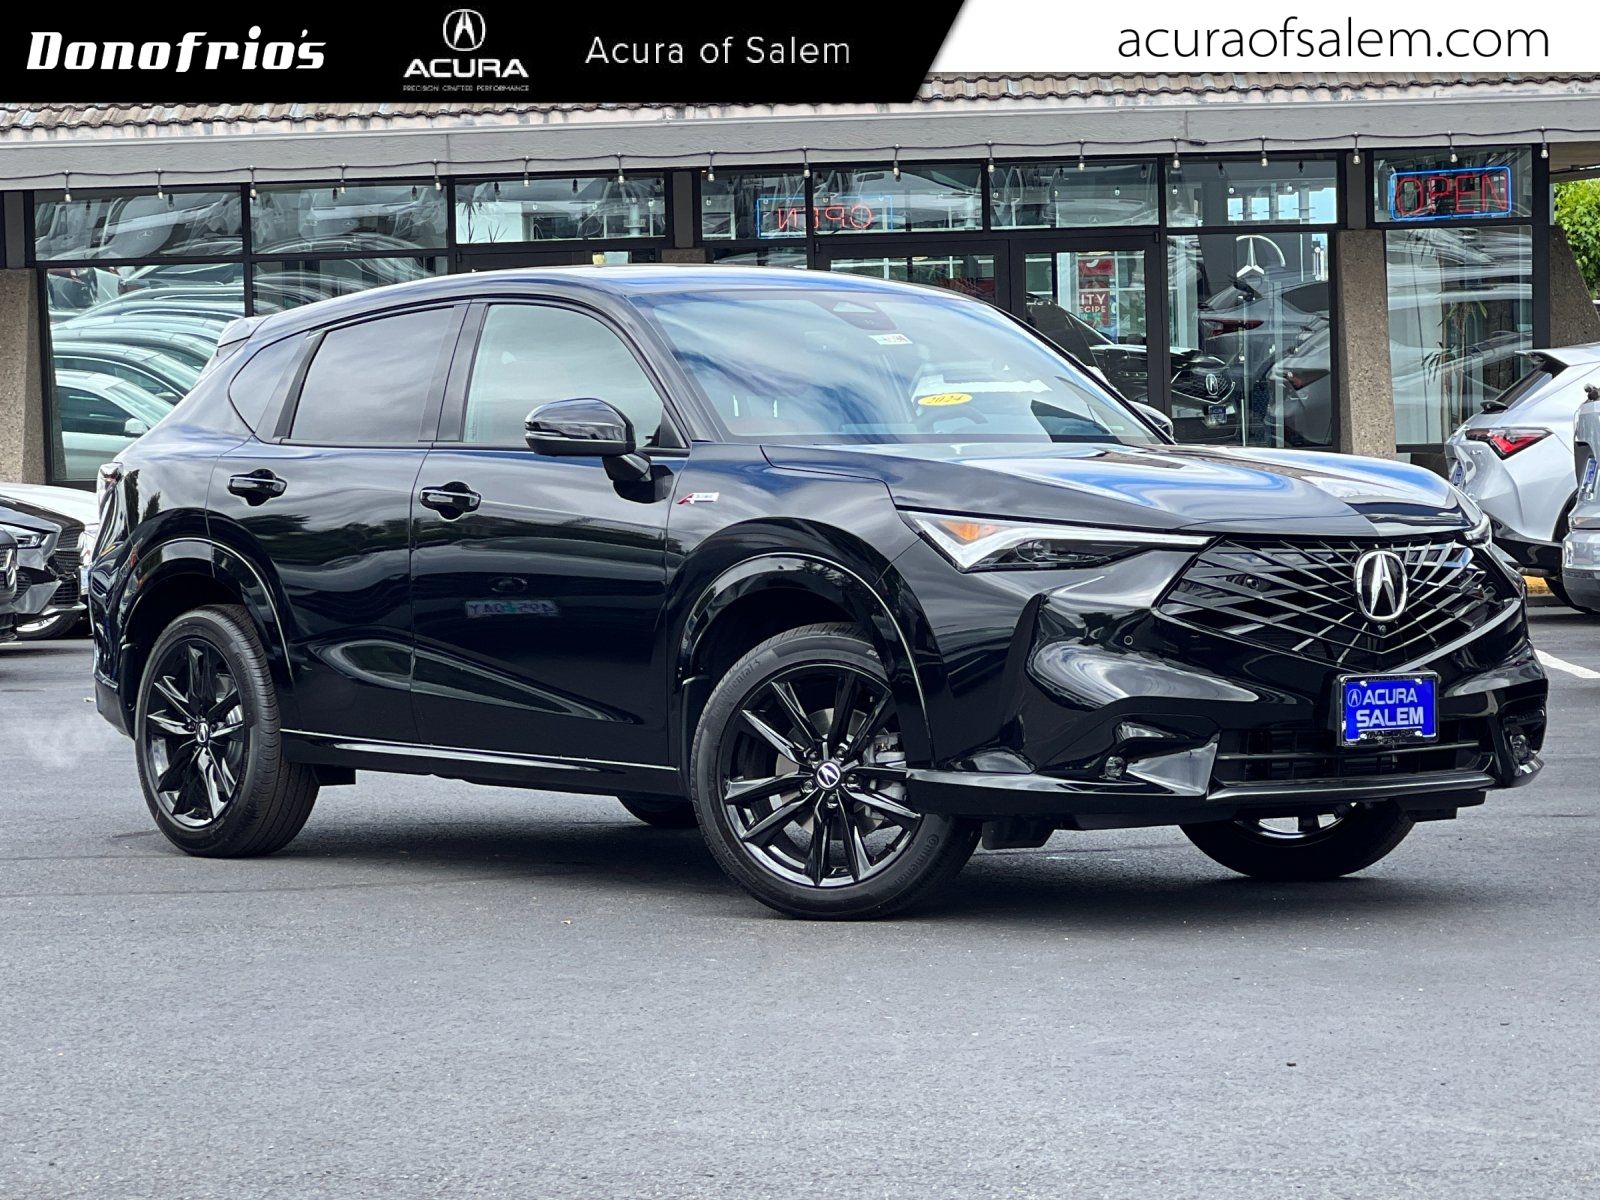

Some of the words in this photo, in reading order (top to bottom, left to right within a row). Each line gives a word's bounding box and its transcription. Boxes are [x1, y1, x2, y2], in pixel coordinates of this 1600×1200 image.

[1396, 173, 1507, 217] OPEN
[1363, 688, 1417, 705] ACURA
[1356, 706, 1424, 727] SALEM
